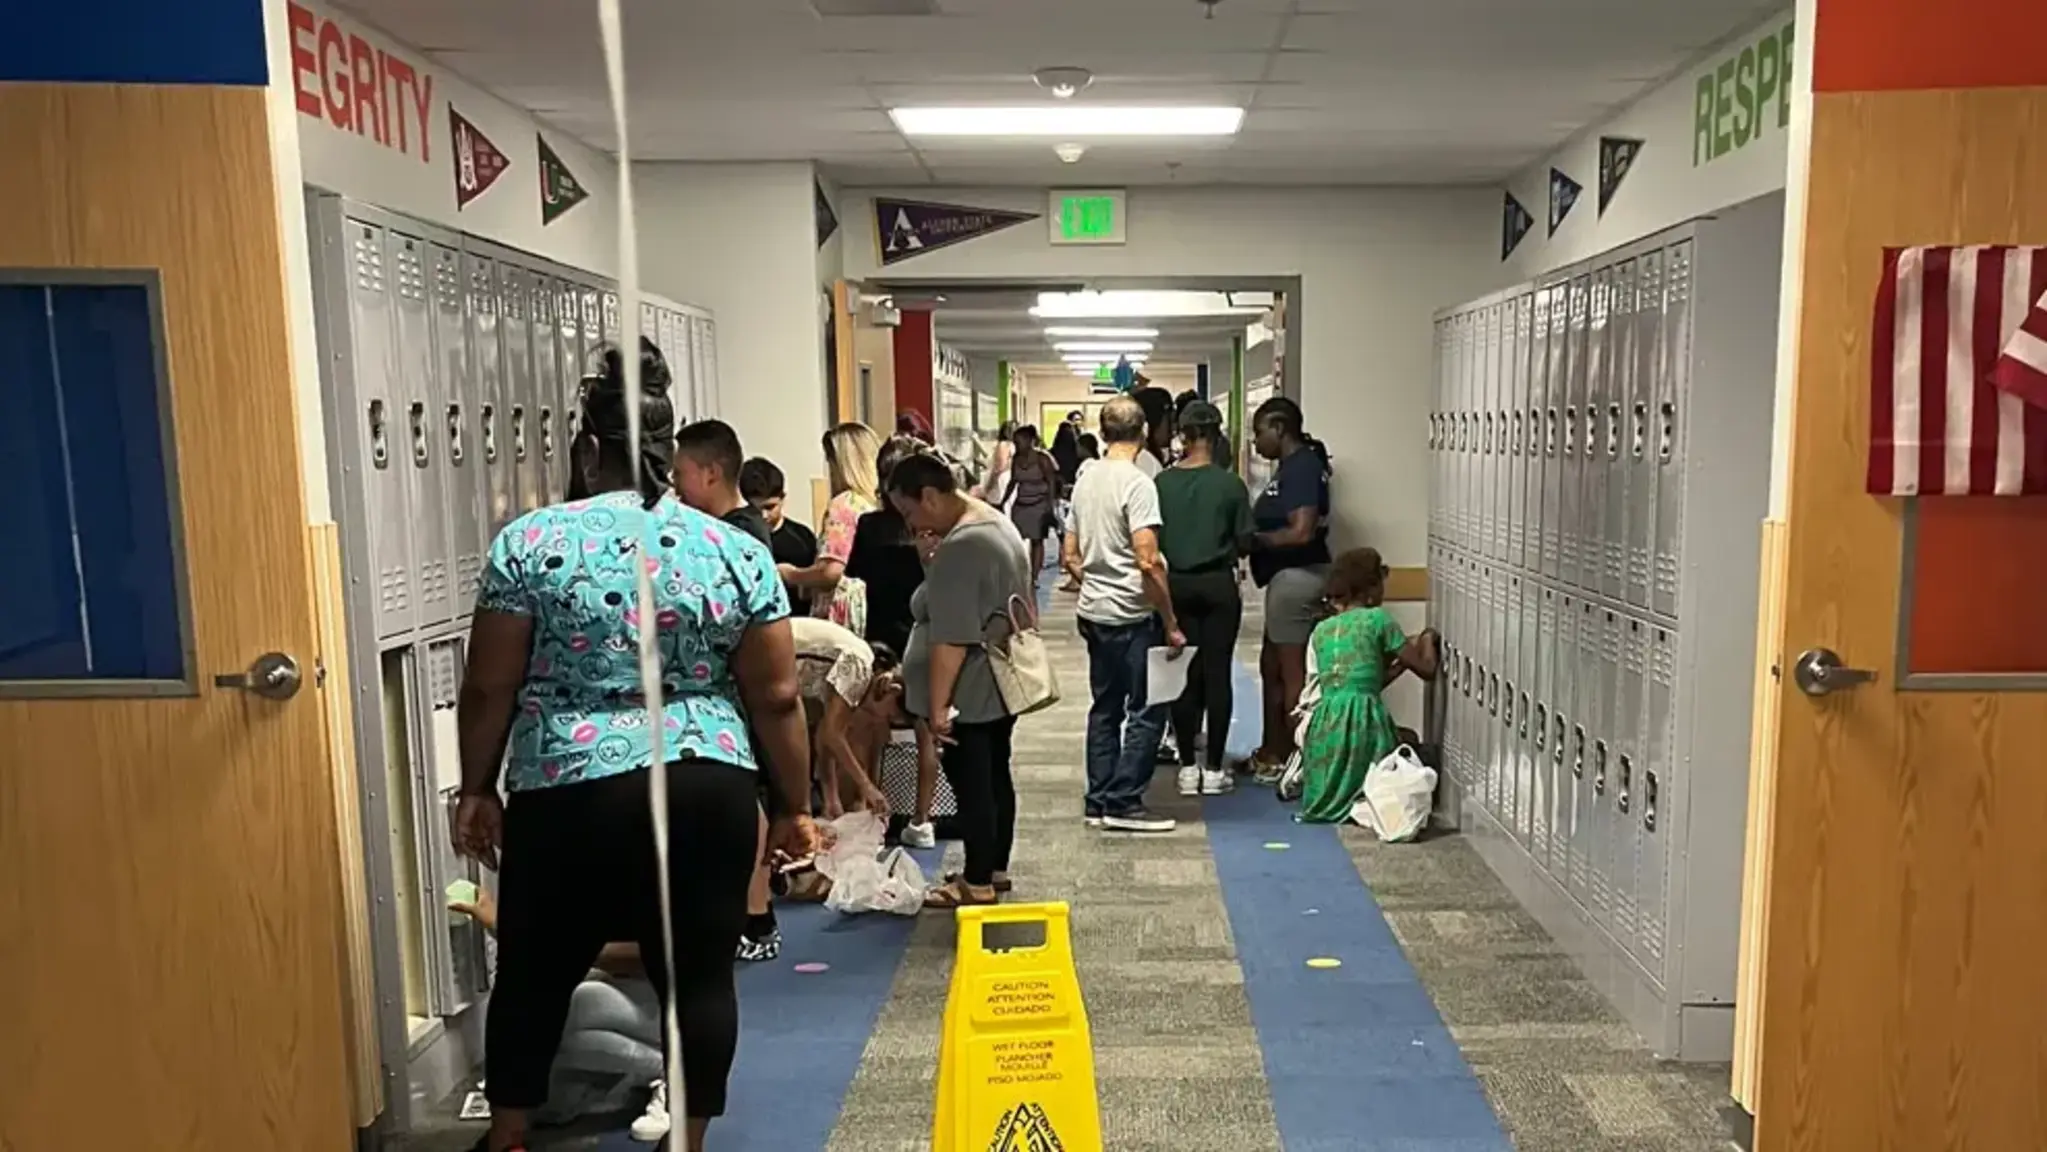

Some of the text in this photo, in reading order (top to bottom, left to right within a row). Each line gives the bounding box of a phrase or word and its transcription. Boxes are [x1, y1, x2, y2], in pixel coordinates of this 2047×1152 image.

[287, 0, 432, 164] EGRITY
[992, 982, 1049, 991] CAUTION
[987, 992, 1055, 1003] ATTENTION
[992, 1004, 1051, 1016] CUIDADO
[992, 1040, 1054, 1051] WET FLOOR
